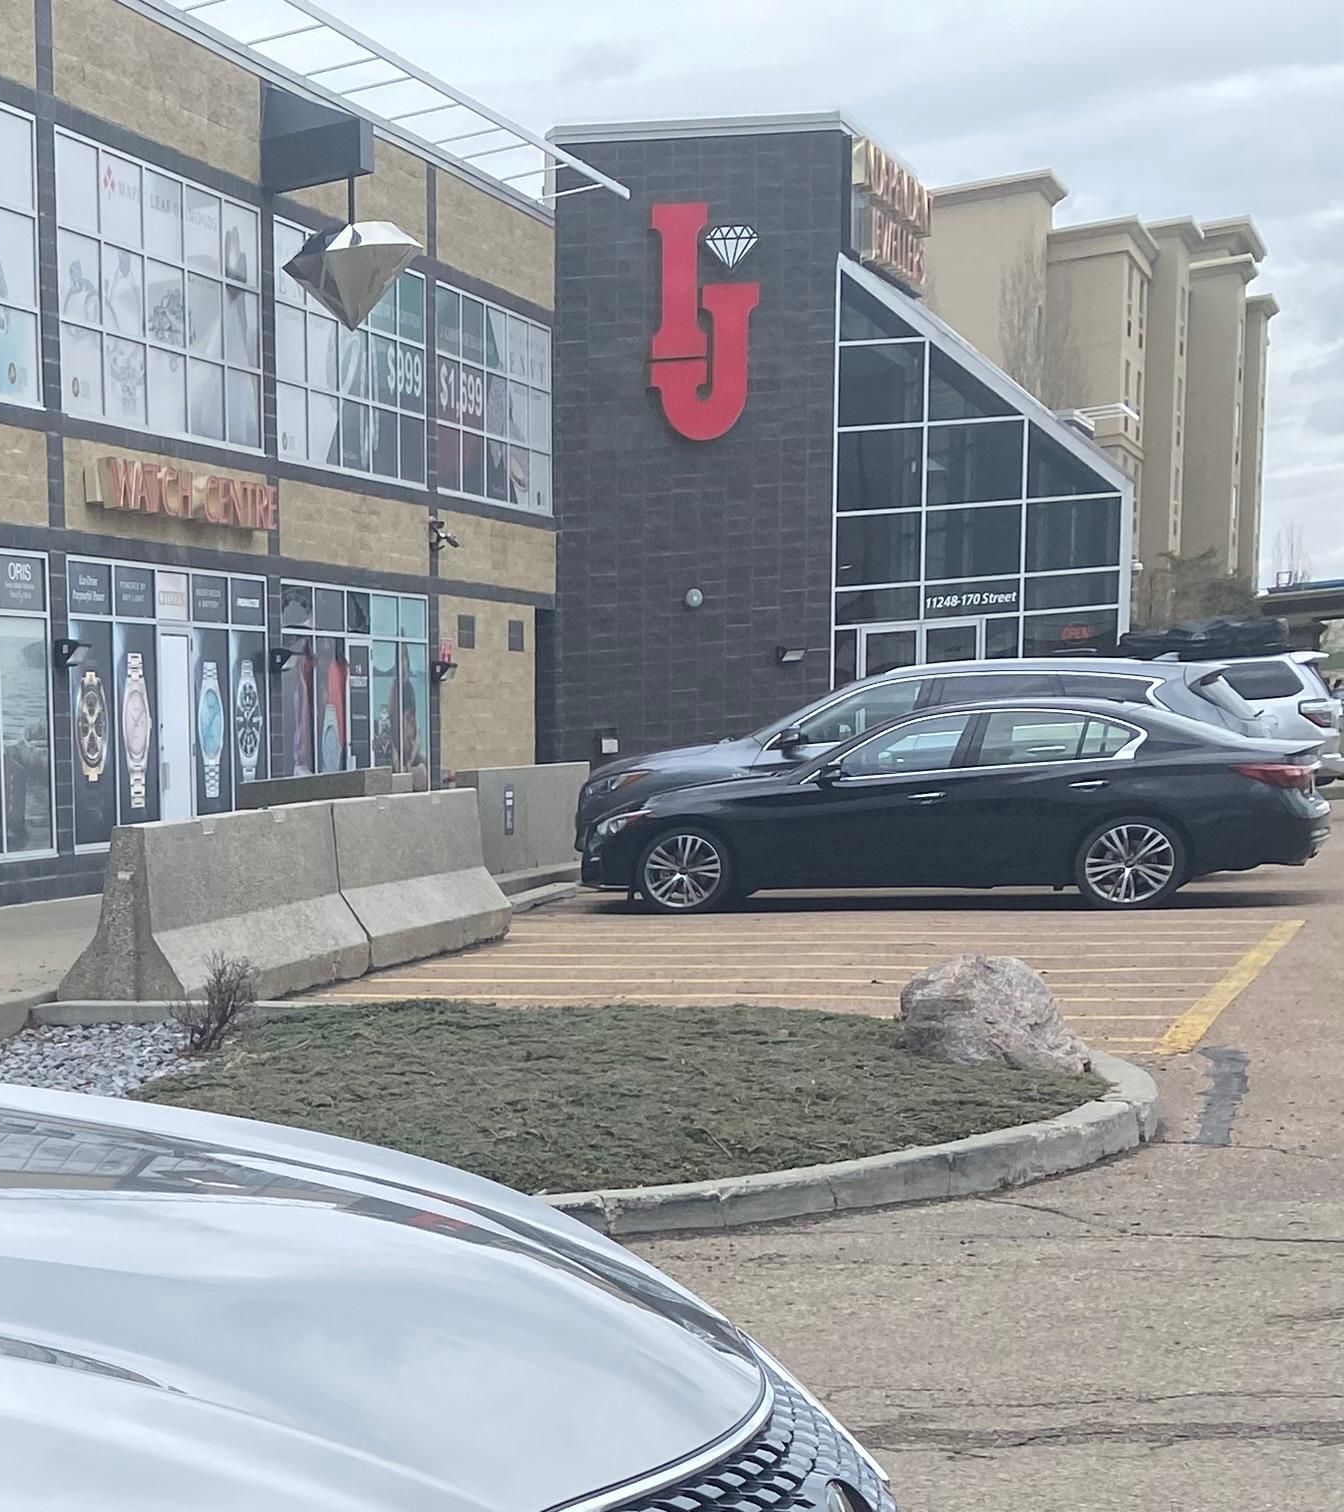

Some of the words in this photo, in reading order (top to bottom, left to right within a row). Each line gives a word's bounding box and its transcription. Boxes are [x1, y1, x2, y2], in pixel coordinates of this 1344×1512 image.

[150, 193, 170, 214] LEAF
[651, 203, 760, 441] IJ
[439, 362, 483, 418] $1,699
[105, 456, 194, 519] WATCH
[204, 474, 278, 530] CENTRE
[7, 562, 32, 581] ORIS
[925, 593, 981, 609] 11248-170
[981, 591, 1017, 605] Street
